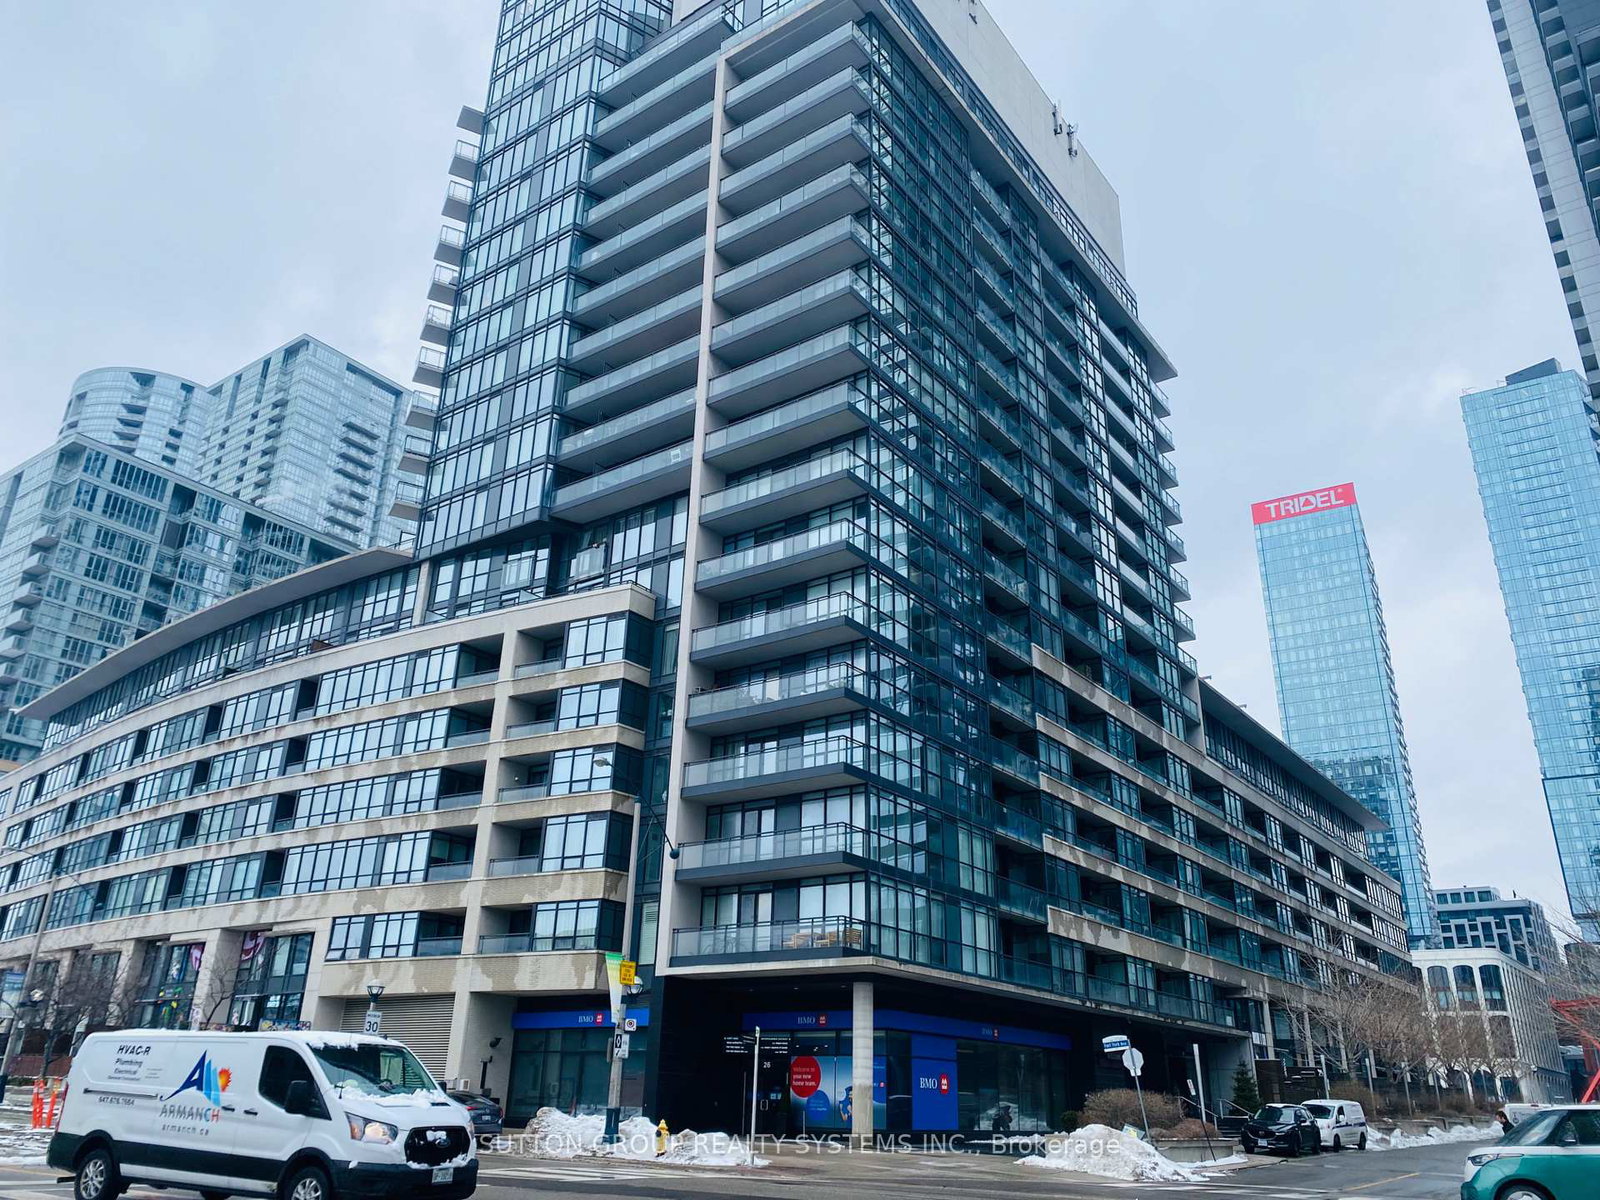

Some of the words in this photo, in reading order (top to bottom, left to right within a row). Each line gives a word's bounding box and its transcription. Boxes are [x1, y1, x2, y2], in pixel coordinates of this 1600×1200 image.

[1265, 488, 1344, 518] TRIDEL
[578, 1015, 594, 1023] BMO
[797, 1016, 816, 1025] BMO
[365, 1021, 379, 1032] 30
[117, 1044, 151, 1055] HVAC-R
[763, 1061, 771, 1069] 26
[919, 1077, 938, 1089] BMO
[159, 1104, 220, 1122] ARMANCH
